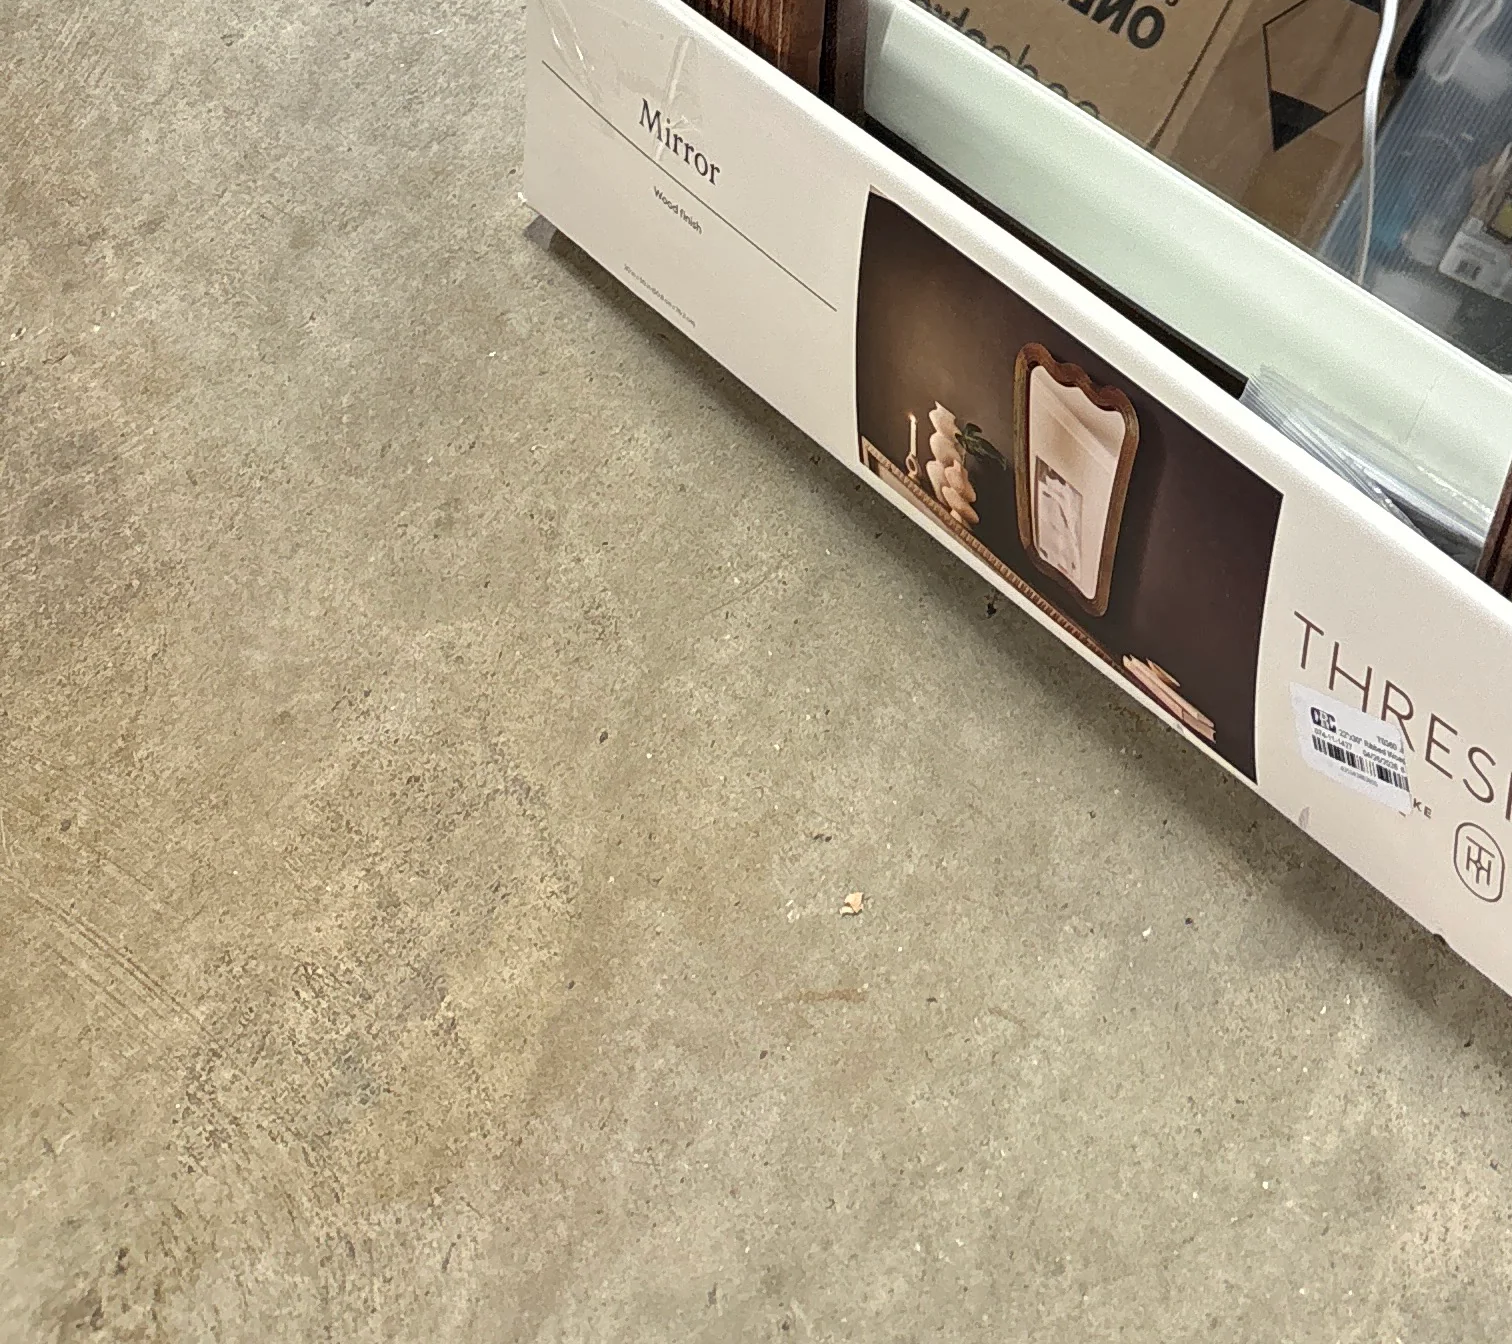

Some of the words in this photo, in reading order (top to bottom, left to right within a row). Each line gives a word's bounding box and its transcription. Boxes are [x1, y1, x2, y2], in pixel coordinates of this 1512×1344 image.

[638, 97, 721, 186] Mirror
[653, 185, 679, 215] Wood
[679, 207, 703, 235] finish
